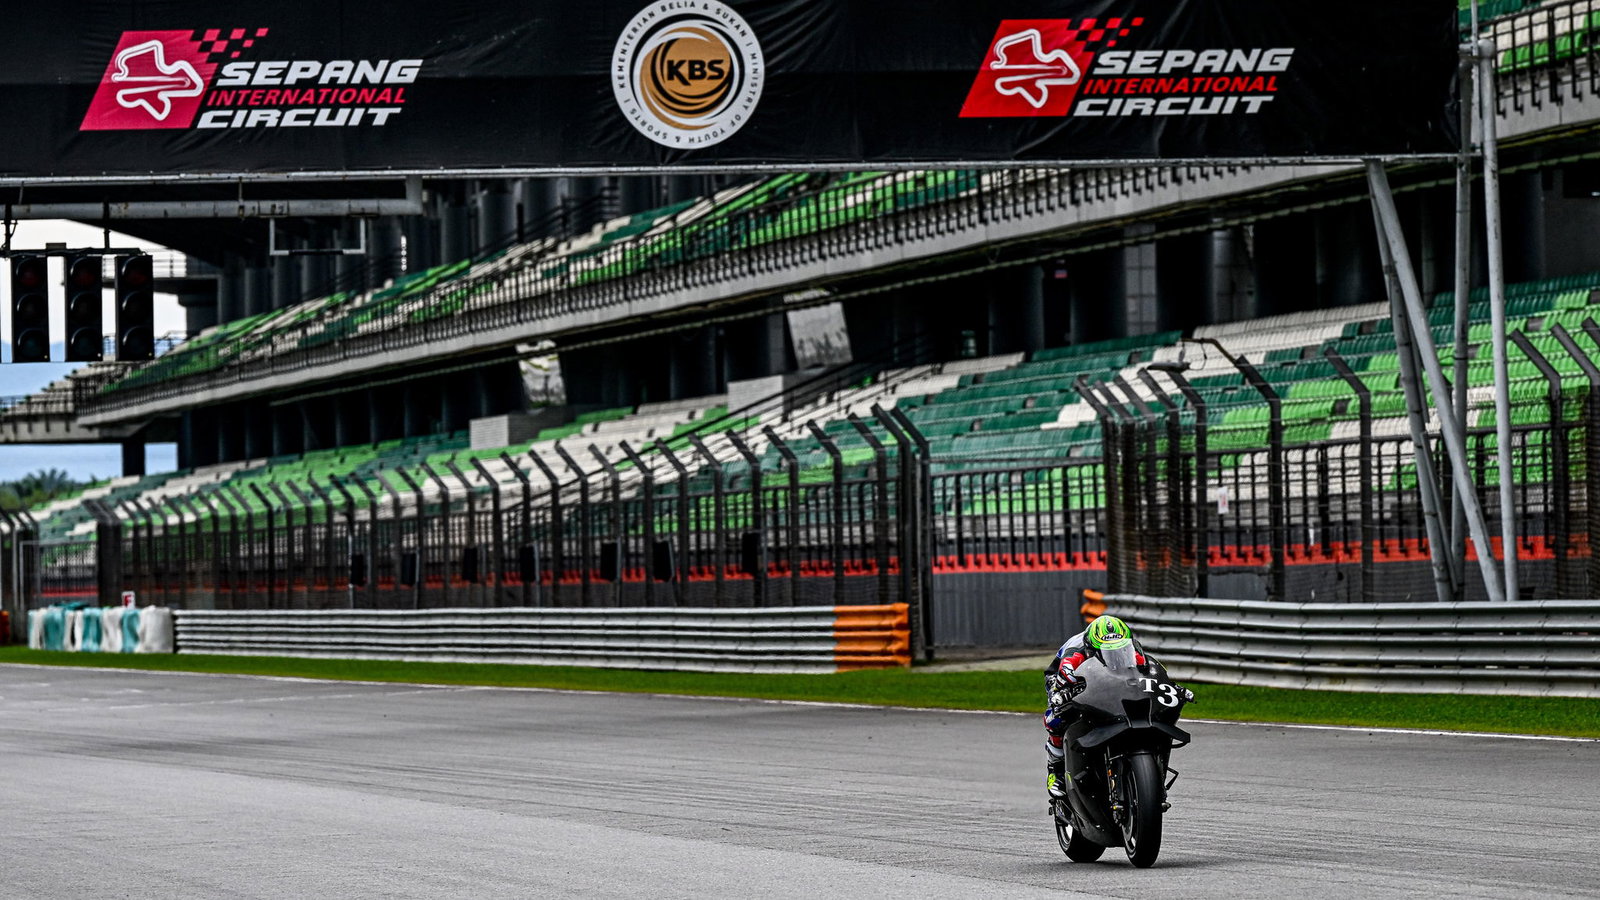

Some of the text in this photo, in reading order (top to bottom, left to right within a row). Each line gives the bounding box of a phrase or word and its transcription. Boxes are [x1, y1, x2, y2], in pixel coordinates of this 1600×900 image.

[617, 11, 656, 89] KEMENTERIAN
[660, 1, 696, 12] BELIA
[715, 8, 747, 37] SUKAN
[216, 59, 424, 86] SEPANG
[667, 59, 725, 86] KBS
[1093, 48, 1295, 75] SEPANG
[742, 52, 759, 111] MINISTRY
[1083, 76, 1278, 94] INTERNATIONAL
[207, 88, 406, 106] INTERNATIONAL
[1073, 95, 1274, 117] CIRCUIT
[197, 107, 401, 129] CIRCUIT
[630, 108, 668, 139] SPORTS
[730, 114, 741, 127] OF
[689, 128, 725, 143] YOUTH
[1138, 677, 1179, 707] T3
